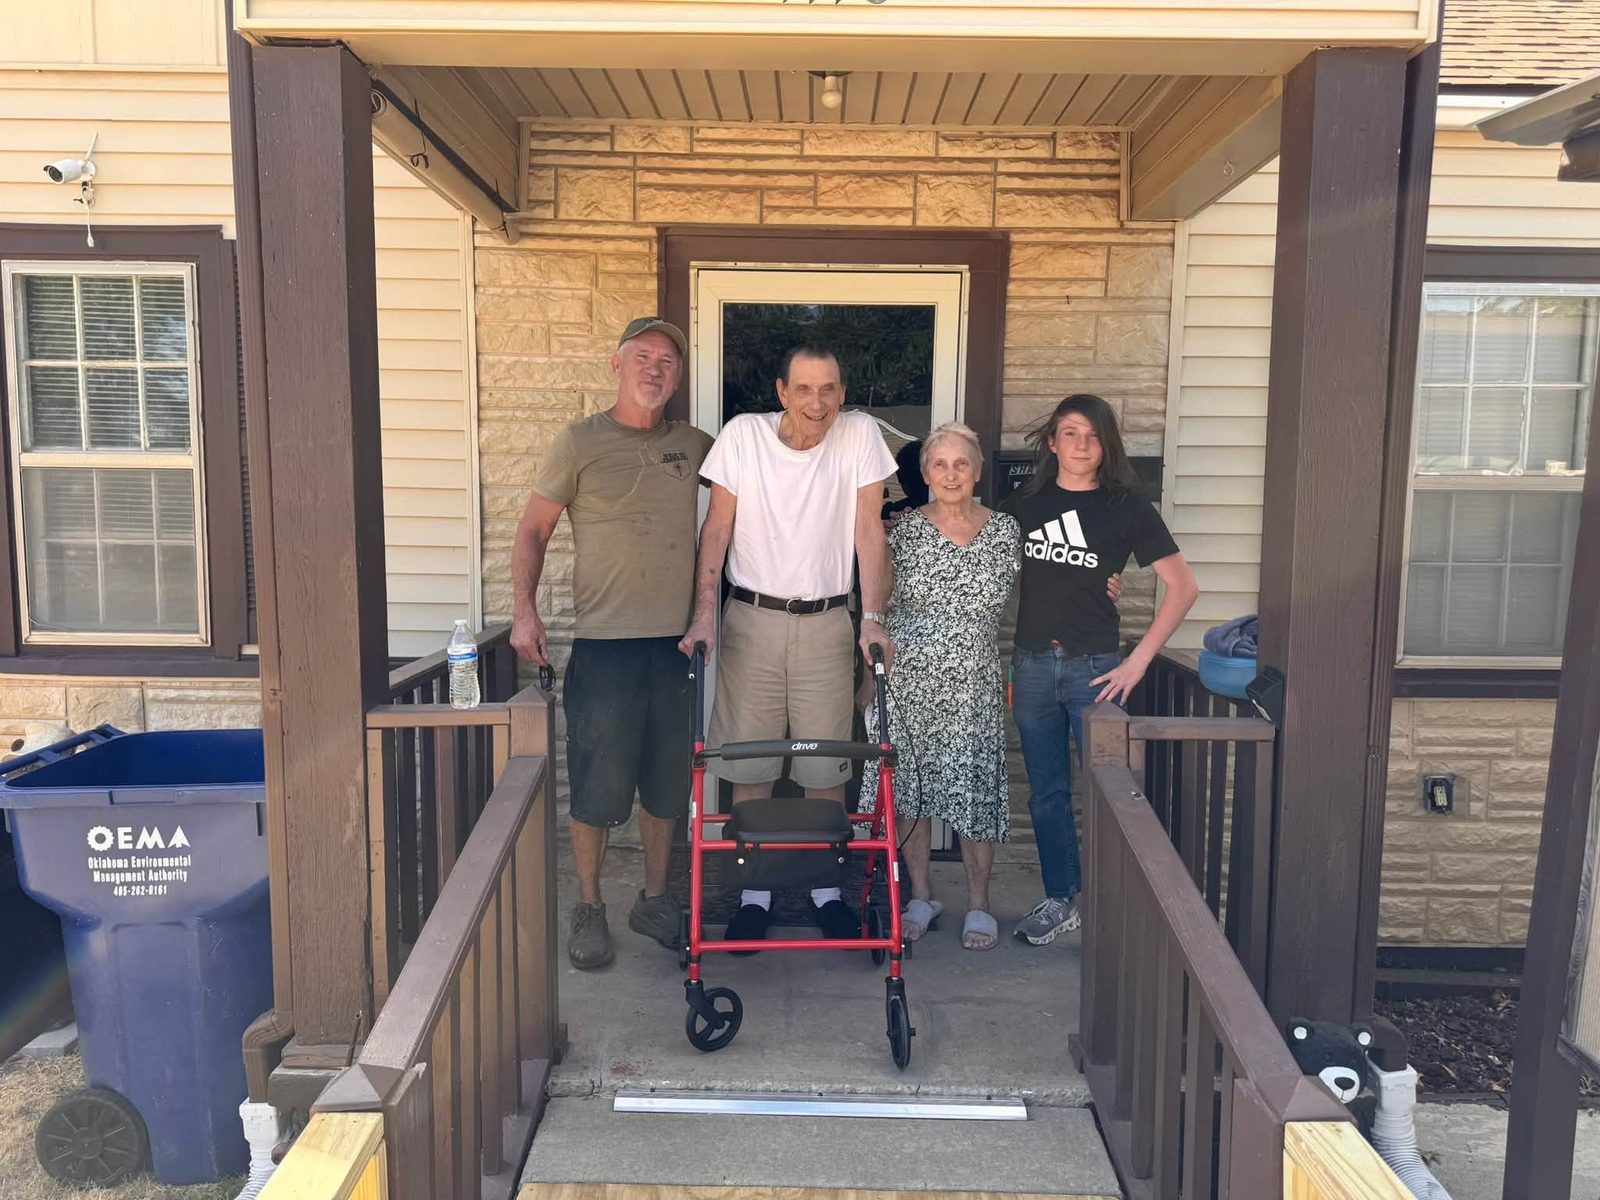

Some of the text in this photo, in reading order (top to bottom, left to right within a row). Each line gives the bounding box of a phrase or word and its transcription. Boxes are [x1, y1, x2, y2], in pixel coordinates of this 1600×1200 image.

[1024, 540, 1099, 568] adidas
[791, 742, 819, 751] drive
[87, 825, 191, 851] OEMA
[88, 854, 191, 869] Oklahoma Environmental
[93, 868, 188, 884] Management Authority
